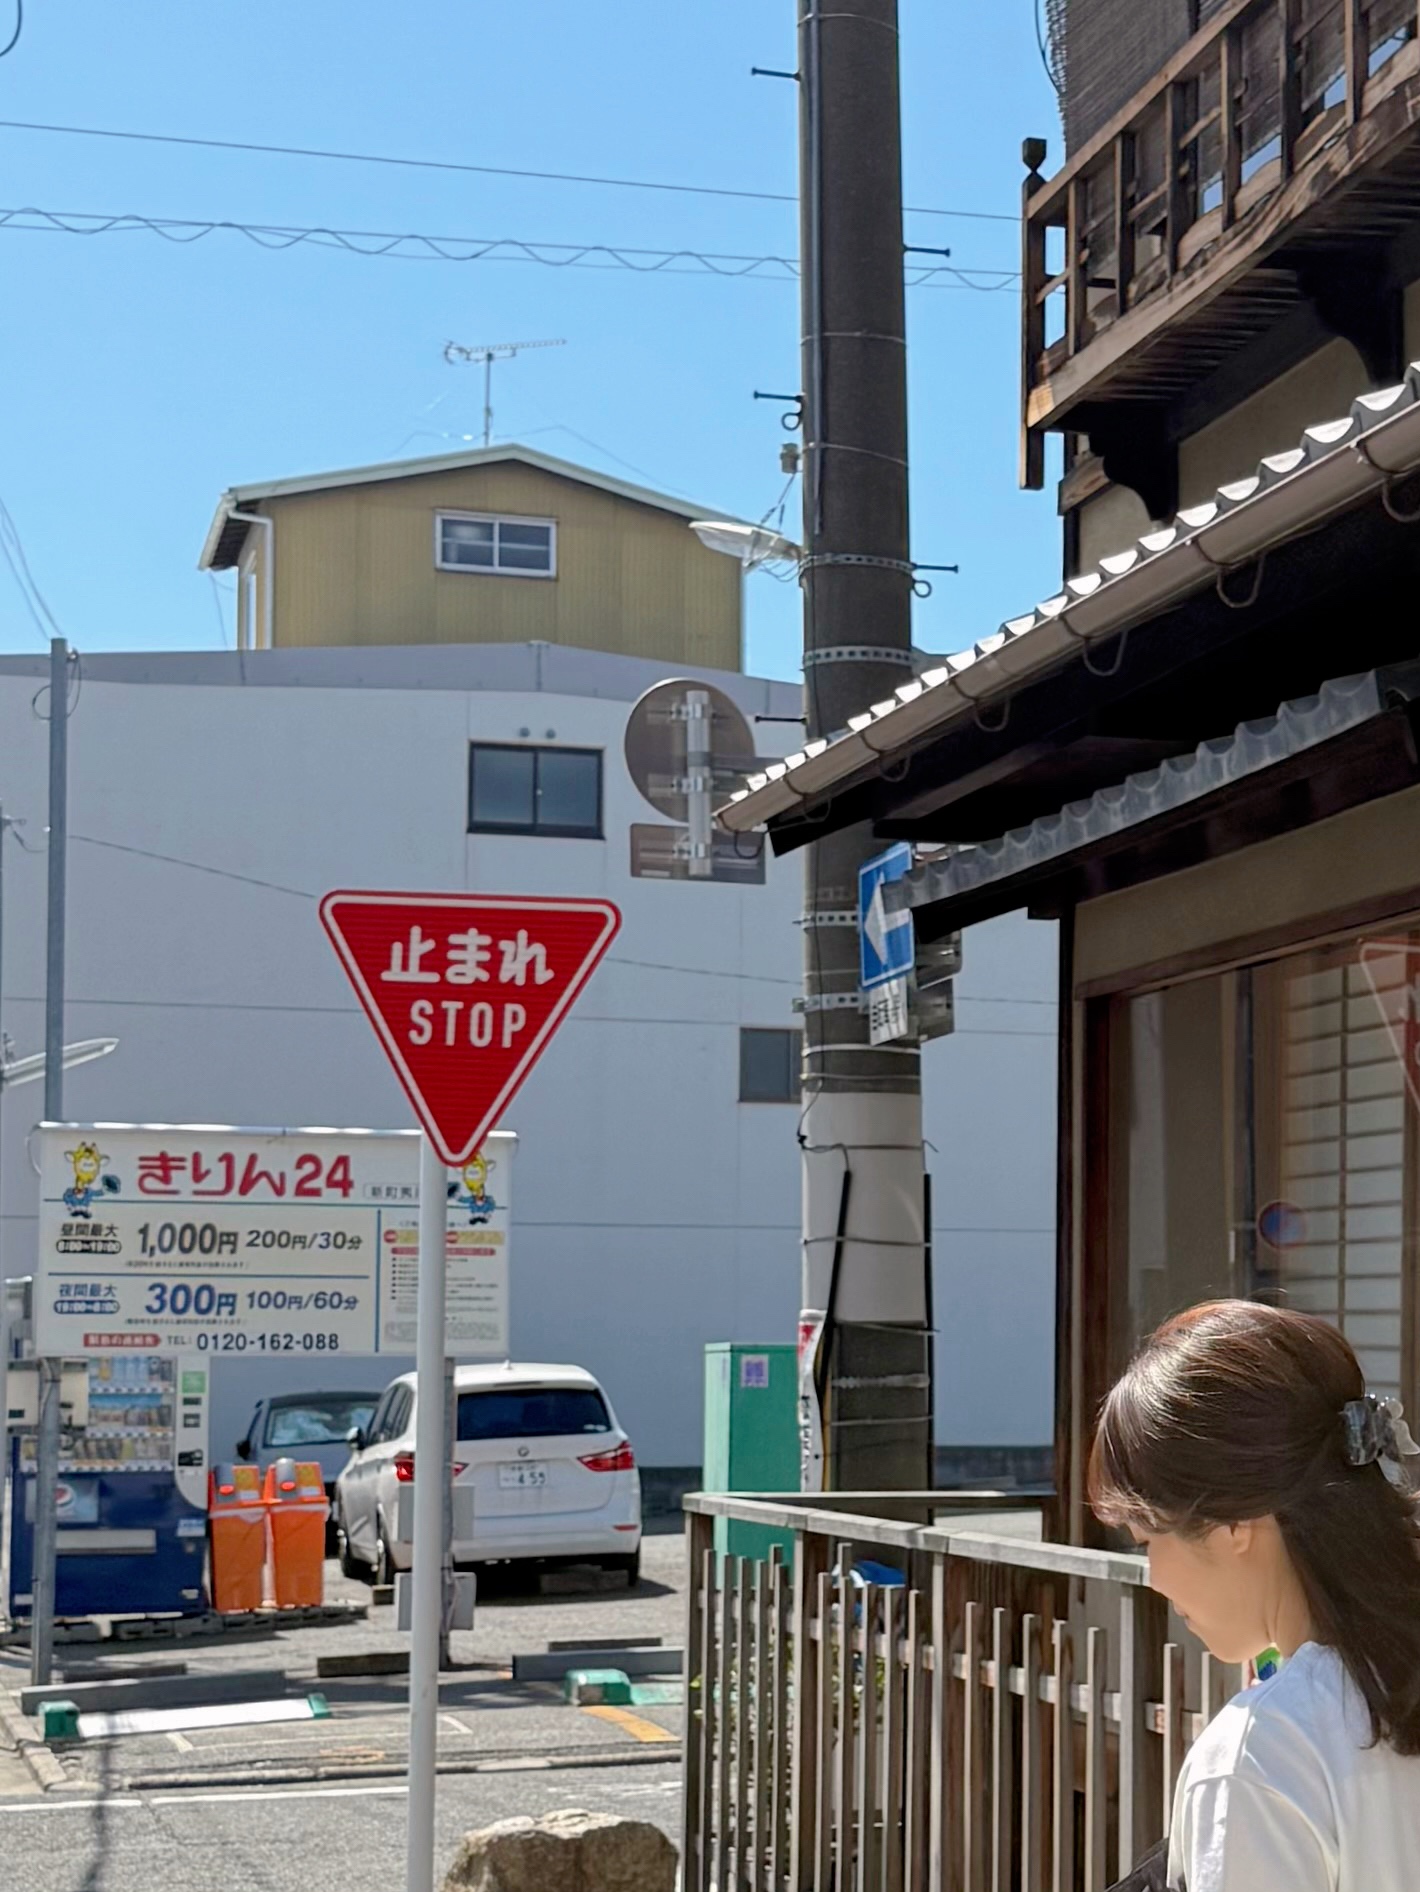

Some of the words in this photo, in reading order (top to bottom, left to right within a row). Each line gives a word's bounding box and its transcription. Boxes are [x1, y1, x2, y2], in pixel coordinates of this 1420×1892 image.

[380, 925, 555, 986] 止まれ
[408, 999, 526, 1048] STOP
[138, 1151, 354, 1197] きりん24
[60, 1223, 119, 1237] 昼間最大
[138, 1223, 239, 1257] 1,000円
[246, 1229, 362, 1251] 200円/30分
[59, 1283, 117, 1298] 夜間最大
[145, 1283, 238, 1316] 300円
[247, 1290, 359, 1311] 100円/60分
[196, 1333, 339, 1351] 0120-162-088
